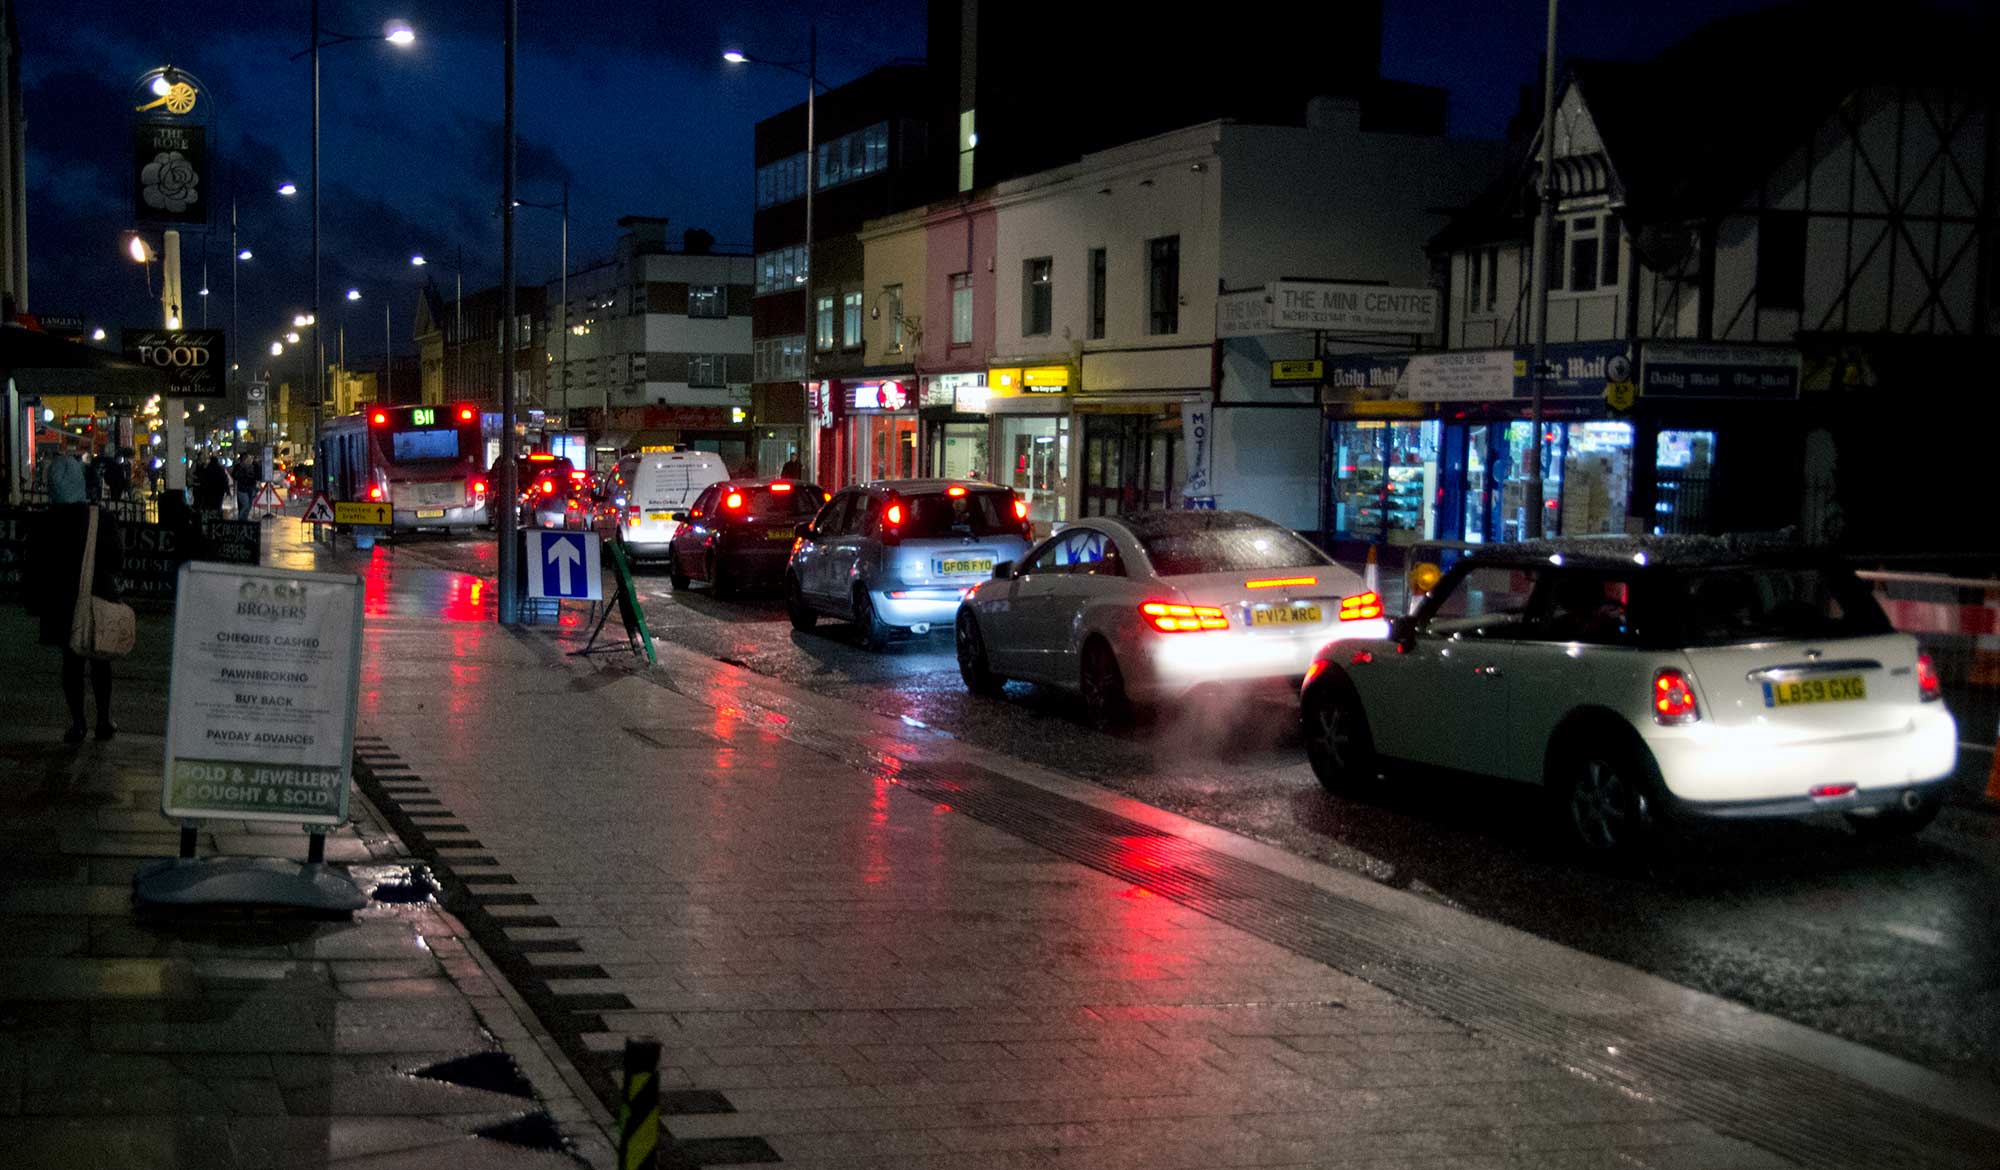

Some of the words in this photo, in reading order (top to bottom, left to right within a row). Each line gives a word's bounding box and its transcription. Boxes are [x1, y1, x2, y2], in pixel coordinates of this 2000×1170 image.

[154, 138, 190, 150] ROSE
[1283, 290, 1315, 310] THE
[1322, 292, 1358, 312] MINI
[1364, 293, 1432, 314] CENTRE
[138, 346, 210, 367] FOOD
[1567, 356, 1606, 379] Mail
[1333, 368, 1366, 391] Daily
[1369, 367, 1398, 387] Mail
[414, 408, 435, 426] B11
[337, 505, 372, 514] Diverted
[119, 527, 176, 553] USE
[943, 560, 970, 573] GF06
[237, 602, 307, 620] BROKERS
[1256, 608, 1288, 623] FV12
[1291, 606, 1317, 622] WRC
[216, 631, 271, 646] CHEQUES
[274, 635, 320, 648] CASHED
[221, 667, 309, 683] PAWNBROKING
[235, 694, 258, 705] BUY
[261, 696, 293, 707] BACK
[1776, 680, 1825, 706] LB59
[1830, 677, 1864, 700] GXG
[206, 729, 250, 742] PAYDAY
[254, 732, 314, 745] ADVANCES
[176, 765, 227, 784] GOLD
[232, 767, 249, 784] &
[251, 768, 341, 788] JEWELLERY
[185, 784, 262, 803] BOUGHT
[265, 787, 284, 804] &
[285, 788, 329, 806] SOLD
